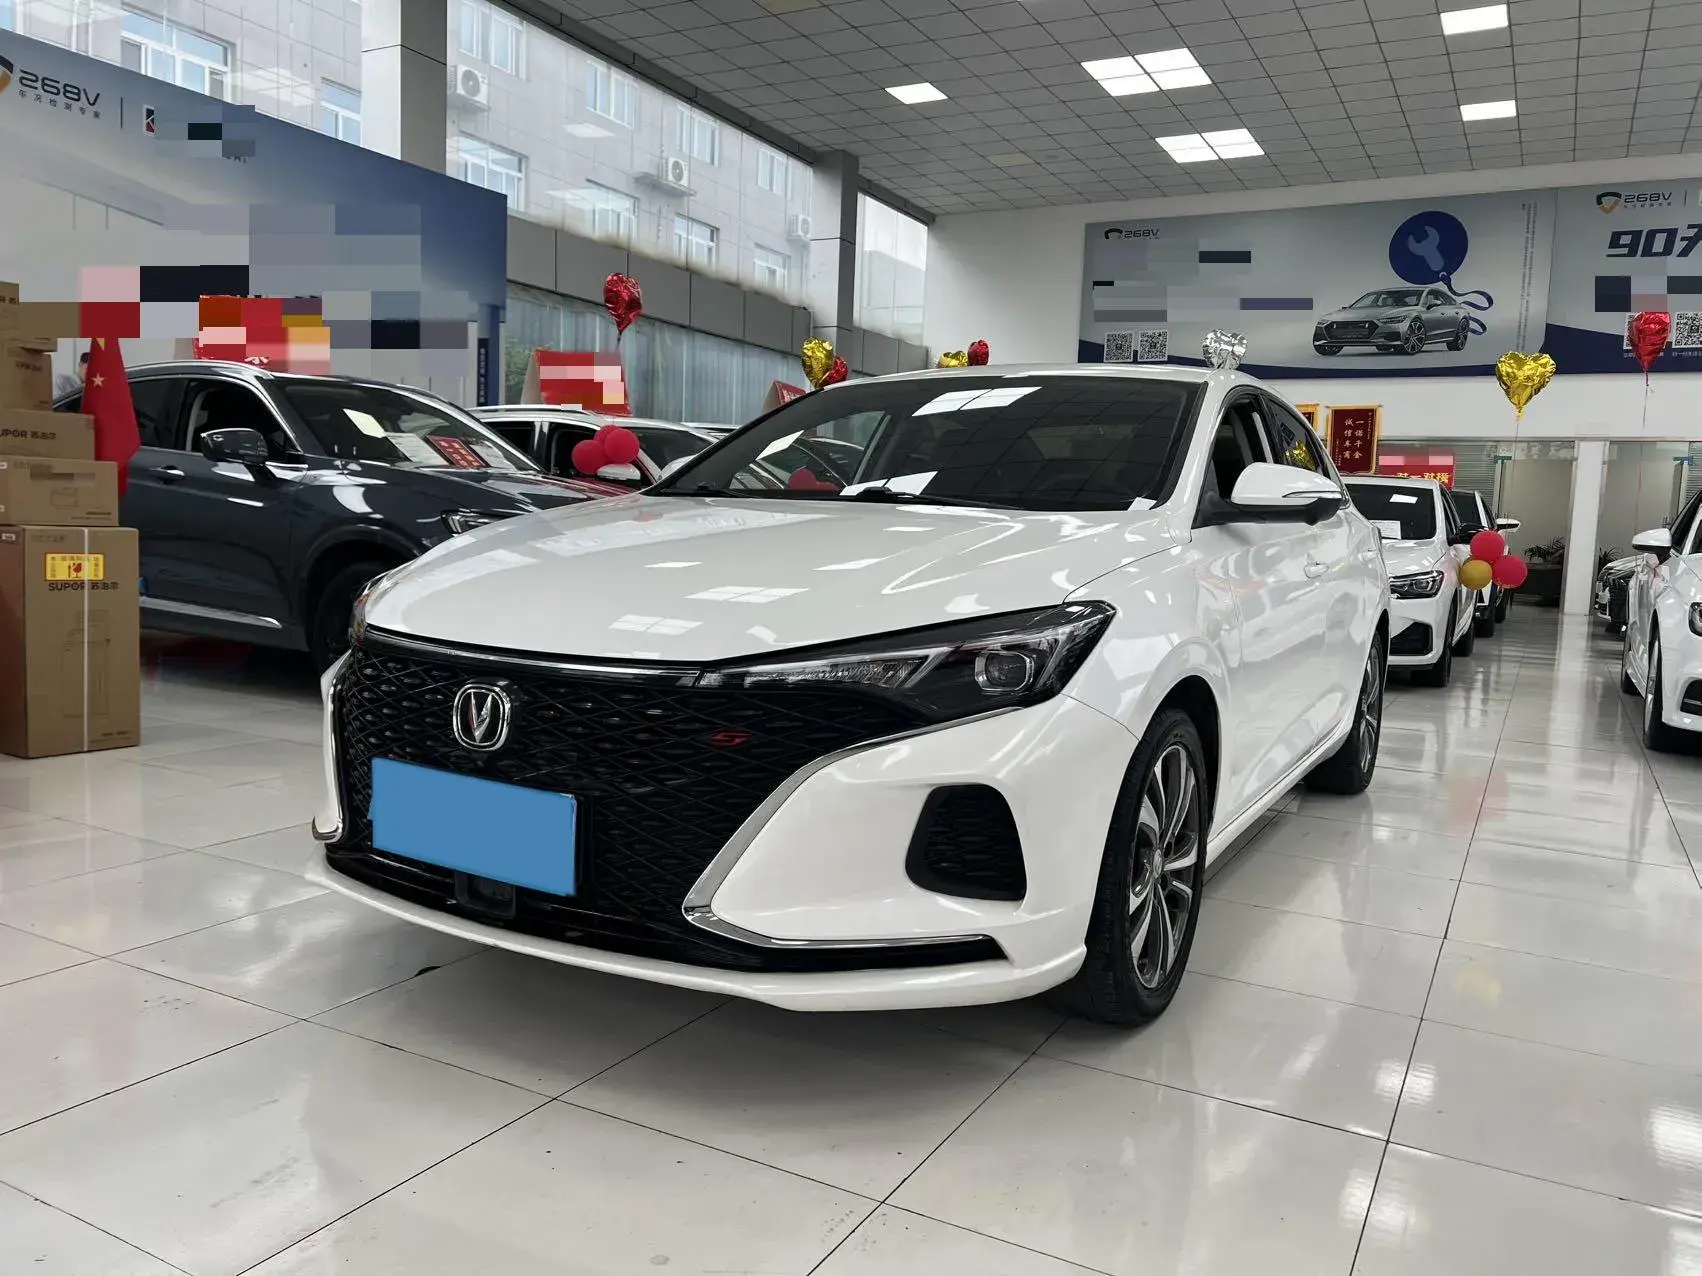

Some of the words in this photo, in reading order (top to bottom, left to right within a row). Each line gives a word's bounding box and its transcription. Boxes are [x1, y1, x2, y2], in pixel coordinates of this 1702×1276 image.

[18, 69, 101, 106] 268V
[1624, 192, 1673, 203] 268V
[1124, 229, 1159, 238] 268V
